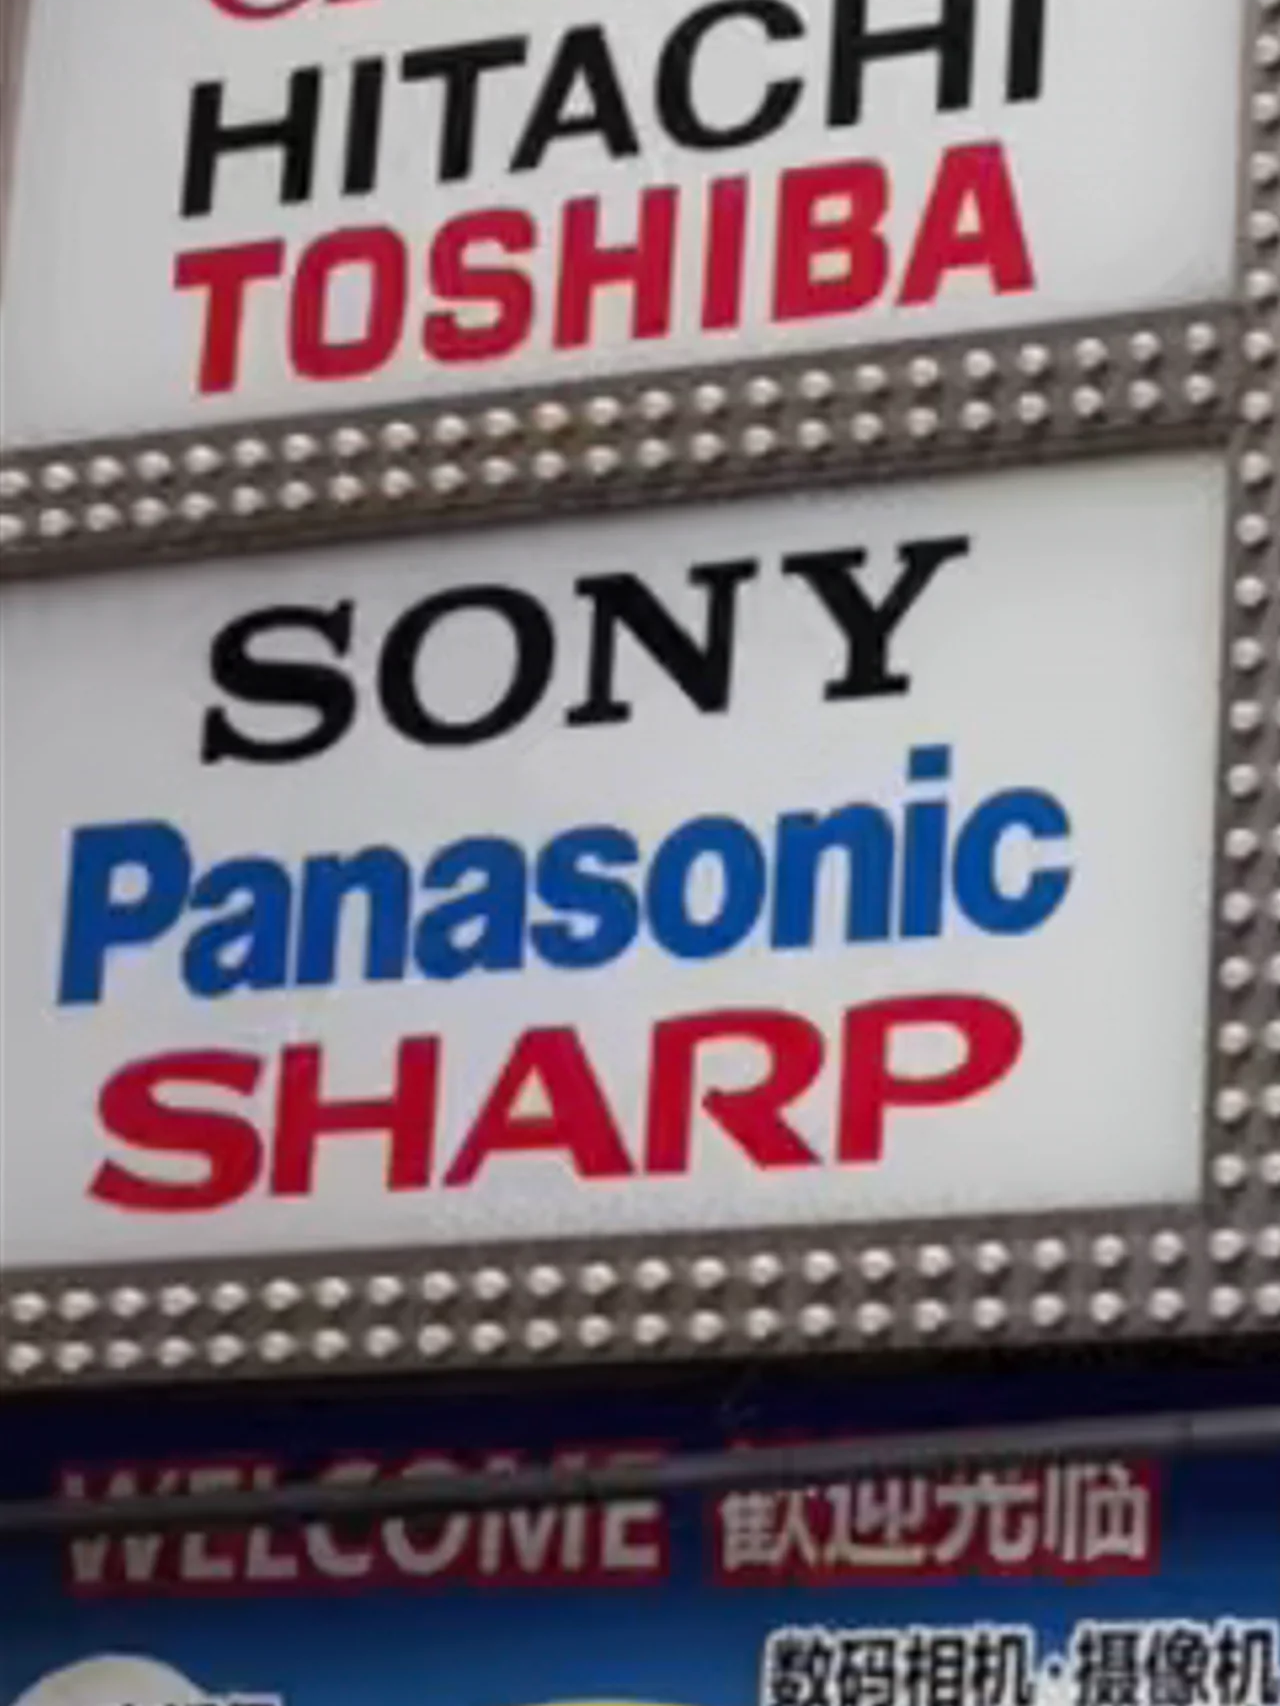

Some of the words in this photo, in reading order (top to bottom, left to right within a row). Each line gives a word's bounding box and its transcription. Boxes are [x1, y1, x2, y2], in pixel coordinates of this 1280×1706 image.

[175, 142, 1034, 393] TOSHIBA
[201, 537, 970, 764] SONY
[58, 745, 1073, 1006] Panasonic
[86, 994, 1023, 1213] SHARP
[63, 1452, 662, 1583] WELCOME
